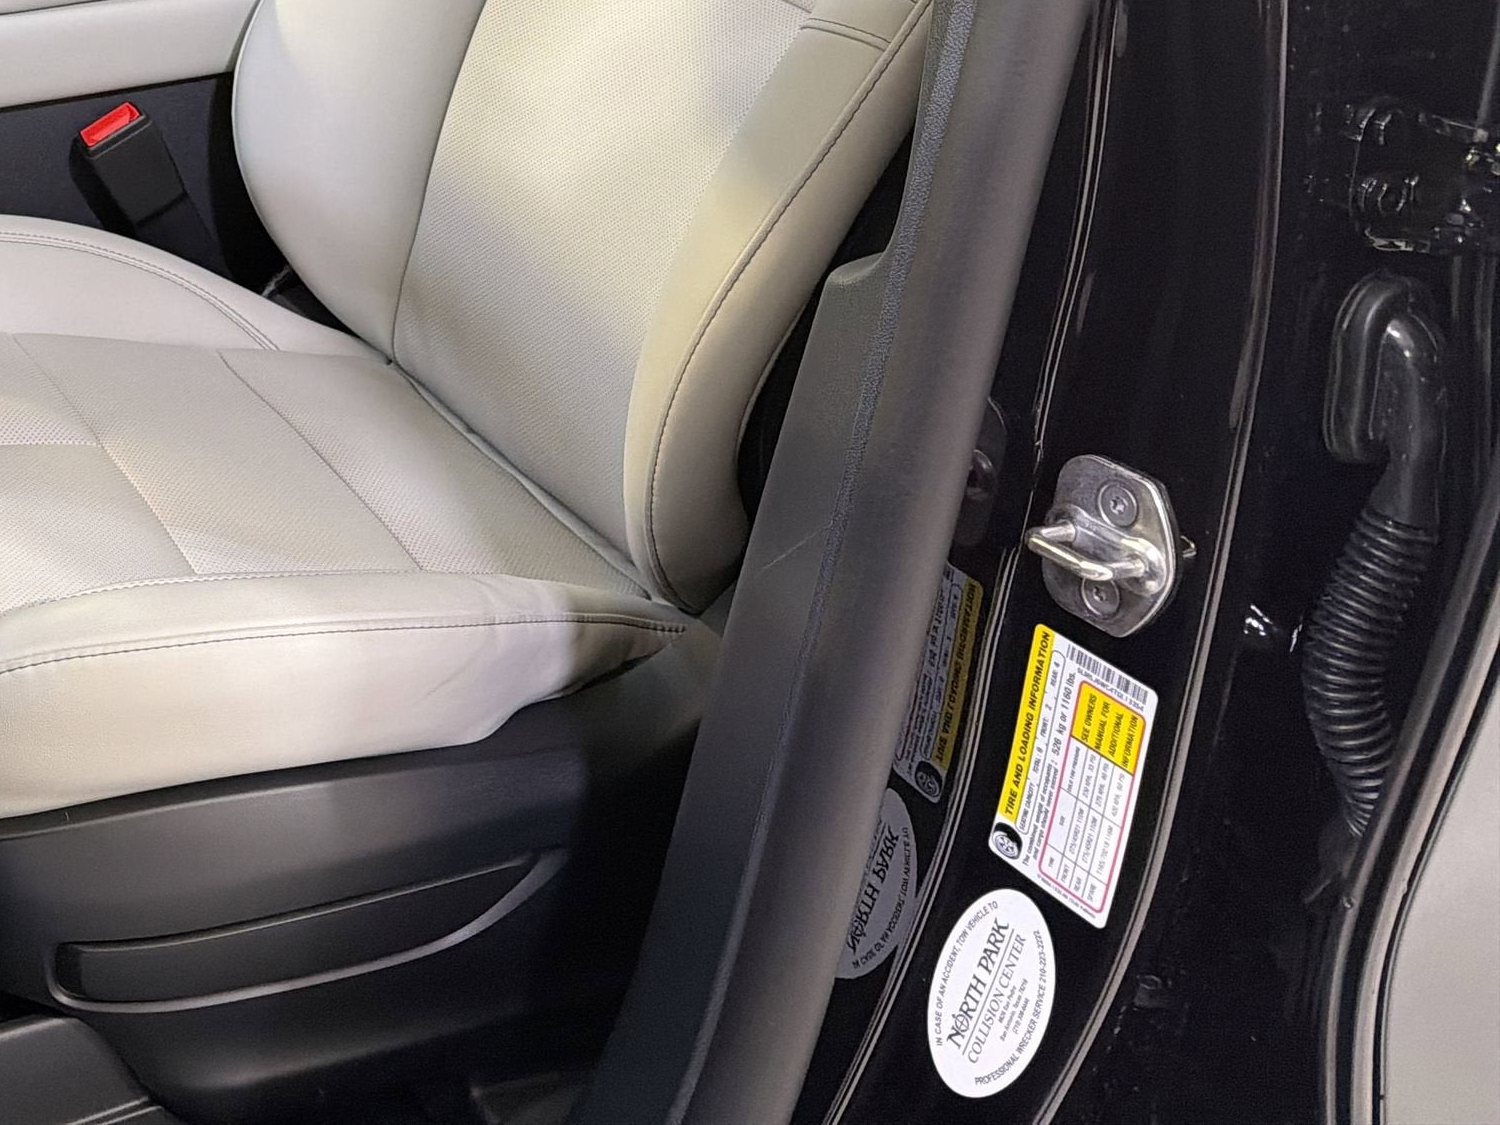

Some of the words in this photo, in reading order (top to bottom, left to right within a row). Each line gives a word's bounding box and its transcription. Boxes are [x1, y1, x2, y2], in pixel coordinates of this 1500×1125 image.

[1027, 630, 1051, 711] INFORMATION
[1065, 668, 1076, 687] lbs.
[1061, 685, 1072, 711] 1160
[1082, 691, 1097, 727] OWNERS
[1055, 721, 1066, 736] kg
[1059, 711, 1066, 723] or
[1093, 716, 1106, 751] MANUAL
[1100, 699, 1110, 717] FOR
[1016, 710, 1034, 762] LOADING
[1079, 723, 1090, 742] SEE
[1106, 710, 1123, 757] ADDITIONAL
[1119, 713, 1138, 769] INFORMATION
[1051, 736, 1062, 756] 526
[1011, 761, 1023, 788] AND
[1005, 787, 1017, 816] TIRE
[964, 904, 990, 930] VEHICLE
[986, 899, 998, 910] TO
[955, 928, 969, 946] TOW
[941, 944, 961, 984] ACCIDENT,
[937, 983, 946, 997] AN
[945, 973, 987, 1049] NORTH
[976, 916, 1009, 974] PARK
[936, 995, 943, 1009] OF
[966, 987, 1004, 1064] COLLISION
[997, 933, 1026, 989] CENTER
[934, 1037, 943, 1045] IN
[974, 1054, 1018, 1083] PROFESSIONAL
[1015, 1018, 1037, 1054] WRECKER
[1031, 984, 1045, 1018] SERVICE
